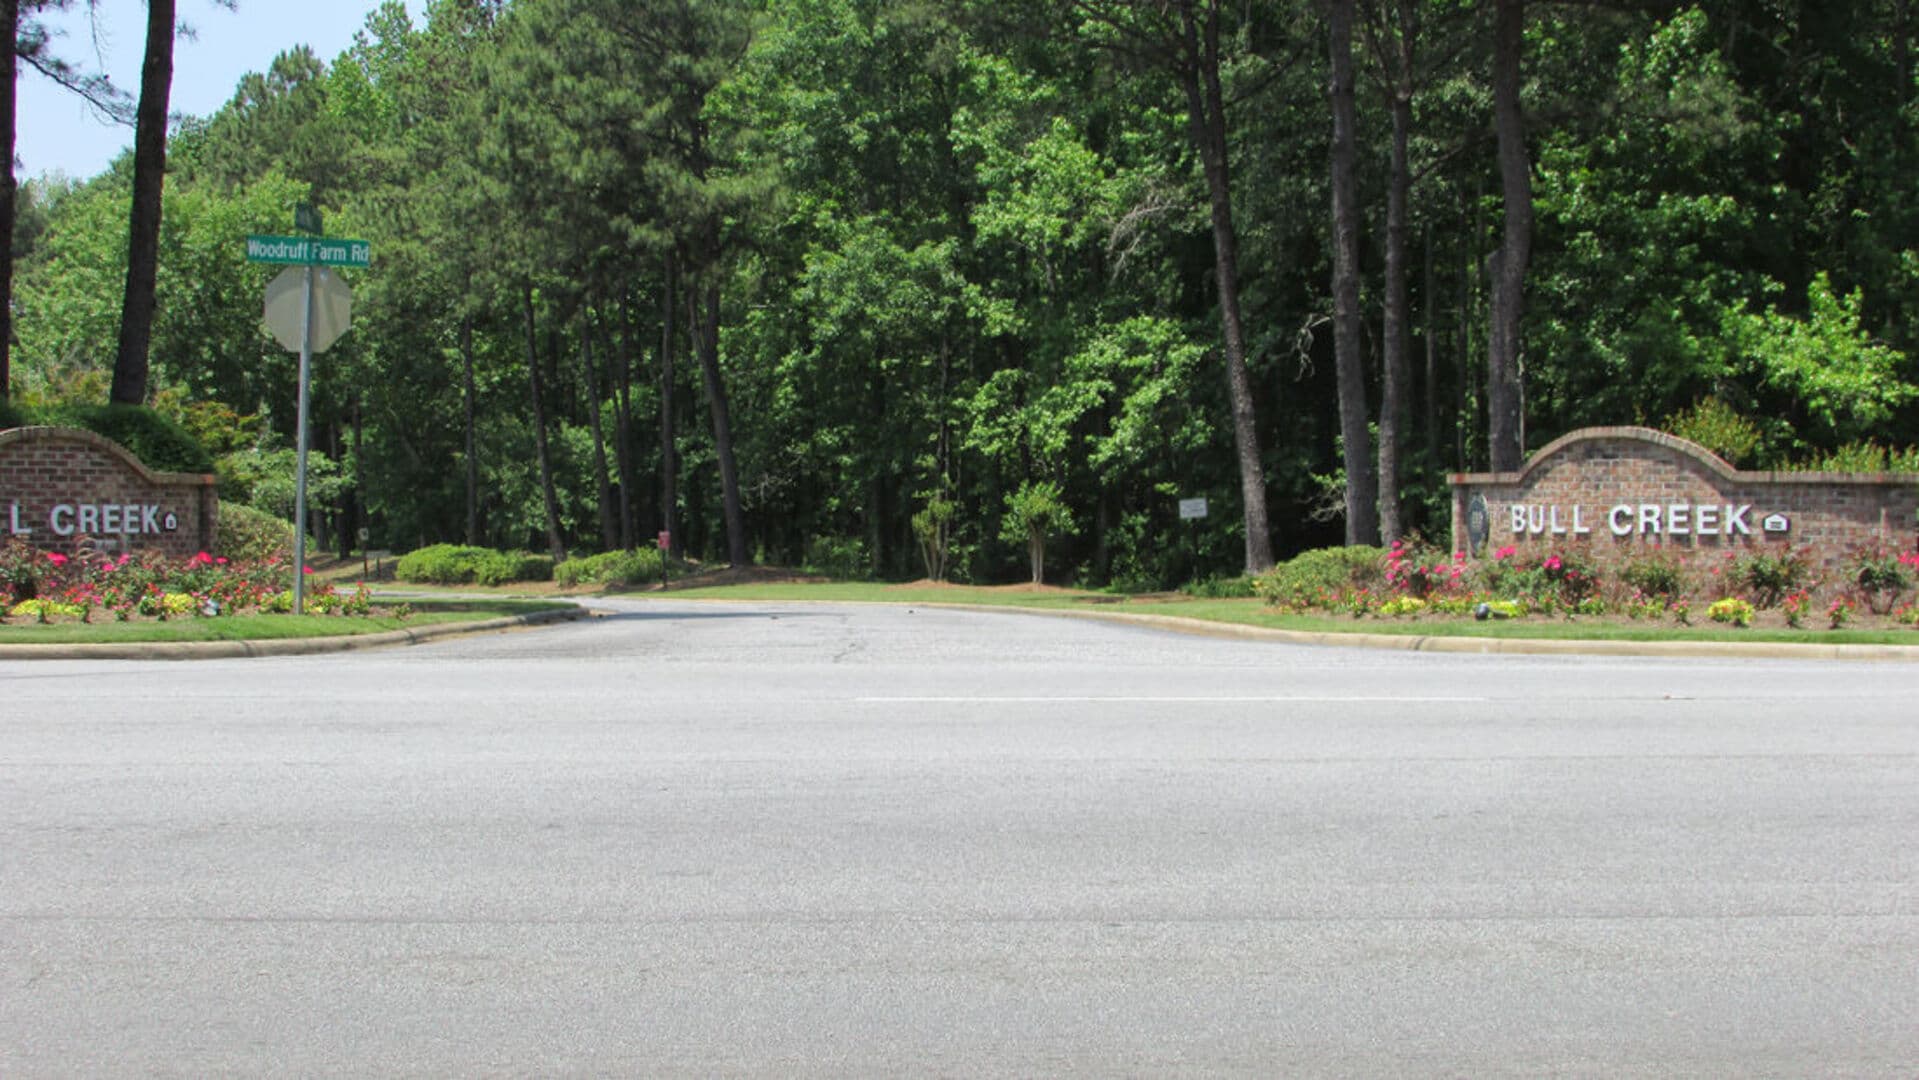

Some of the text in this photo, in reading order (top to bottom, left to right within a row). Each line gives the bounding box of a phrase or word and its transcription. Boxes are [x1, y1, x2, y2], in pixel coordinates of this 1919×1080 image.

[247, 240, 369, 261] Woodruff Farm Rd
[51, 503, 161, 536] CREEK
[1511, 504, 1590, 534] BULL
[1609, 503, 1751, 535] CREEK
